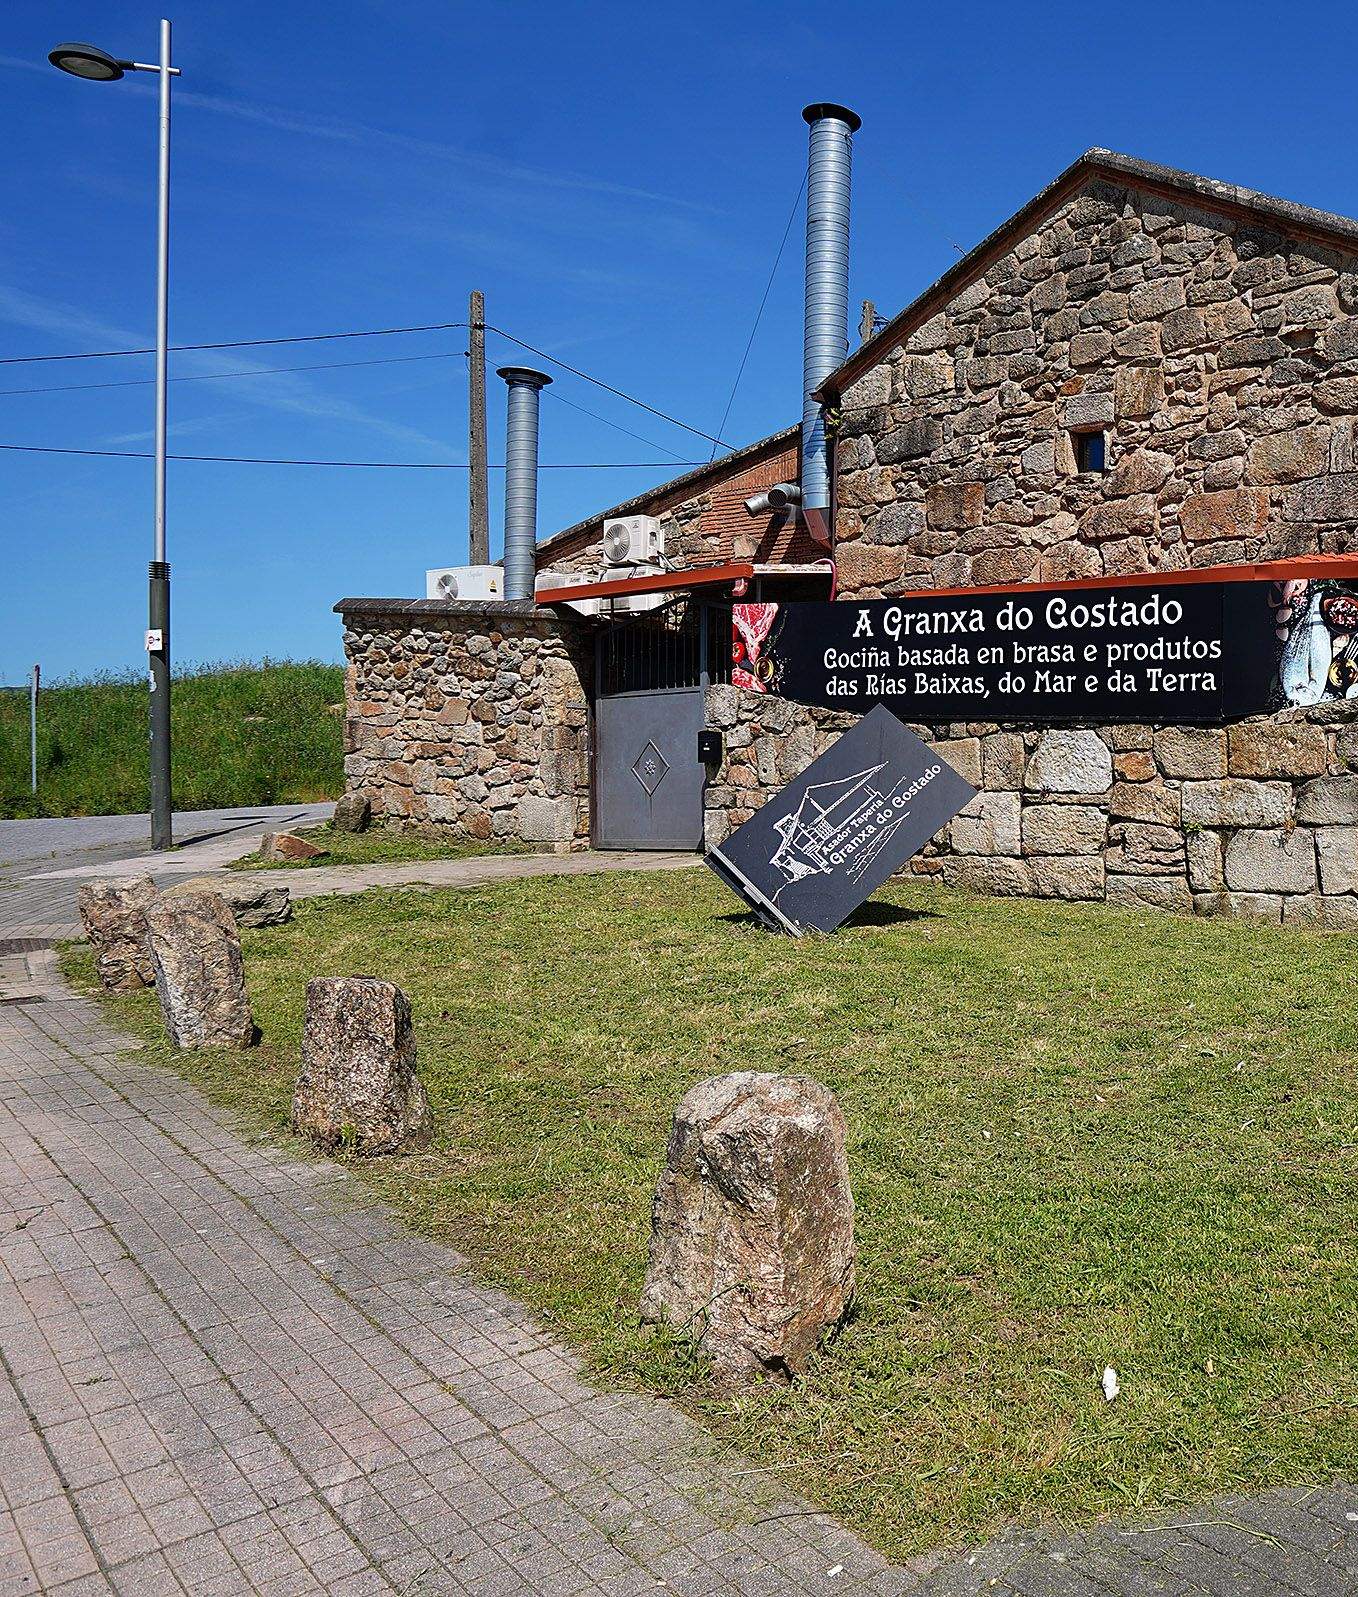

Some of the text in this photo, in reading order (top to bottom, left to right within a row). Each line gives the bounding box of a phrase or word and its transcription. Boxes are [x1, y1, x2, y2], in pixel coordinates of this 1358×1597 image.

[852, 594, 1183, 641] A Granxa do Costado
[823, 636, 1222, 669] Cociña basada en brasa e produtos
[825, 668, 1217, 698] das Rías Baixas, do Mar e da Terra
[829, 764, 941, 865] Granxa do Costado
[821, 826, 852, 855] Asador
